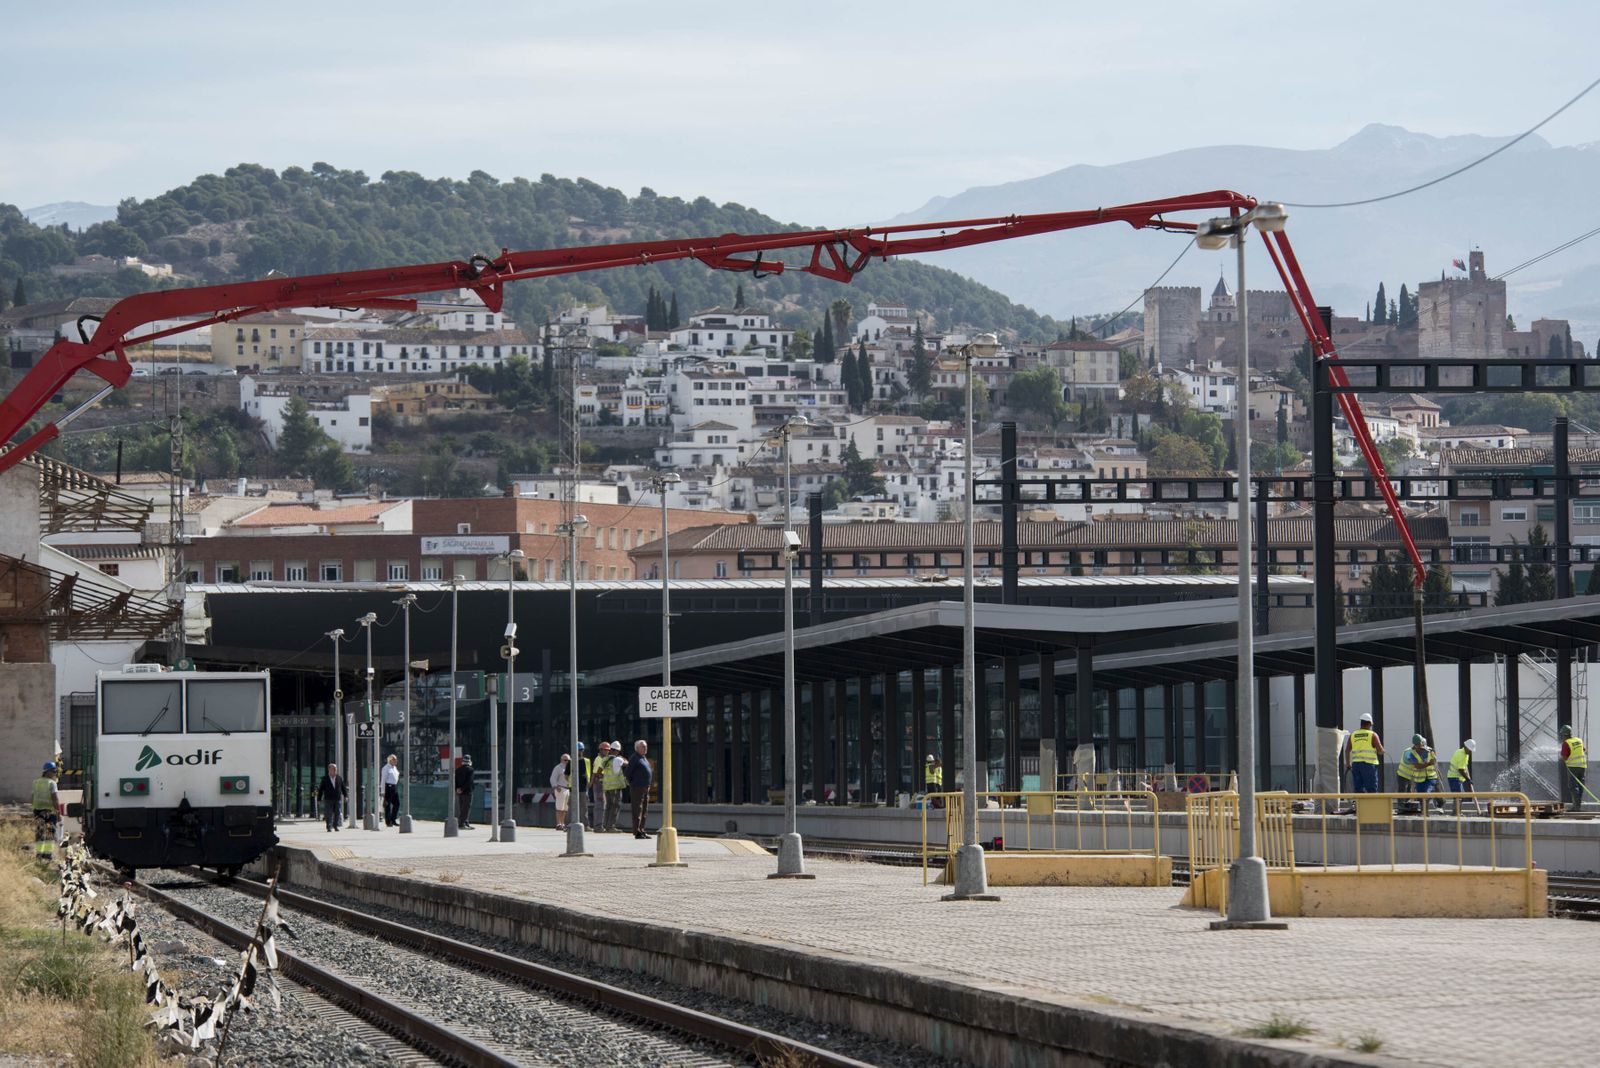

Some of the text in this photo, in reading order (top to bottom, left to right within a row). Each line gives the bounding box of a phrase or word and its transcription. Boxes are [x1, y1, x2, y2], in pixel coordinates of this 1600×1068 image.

[457, 685, 465, 698] 7
[522, 687, 530, 700] 3
[650, 689, 688, 699] CABEZA
[645, 701, 694, 712] DE TREN
[347, 713, 354, 724] 7
[398, 711, 405, 722] 3
[166, 749, 224, 765] adif
